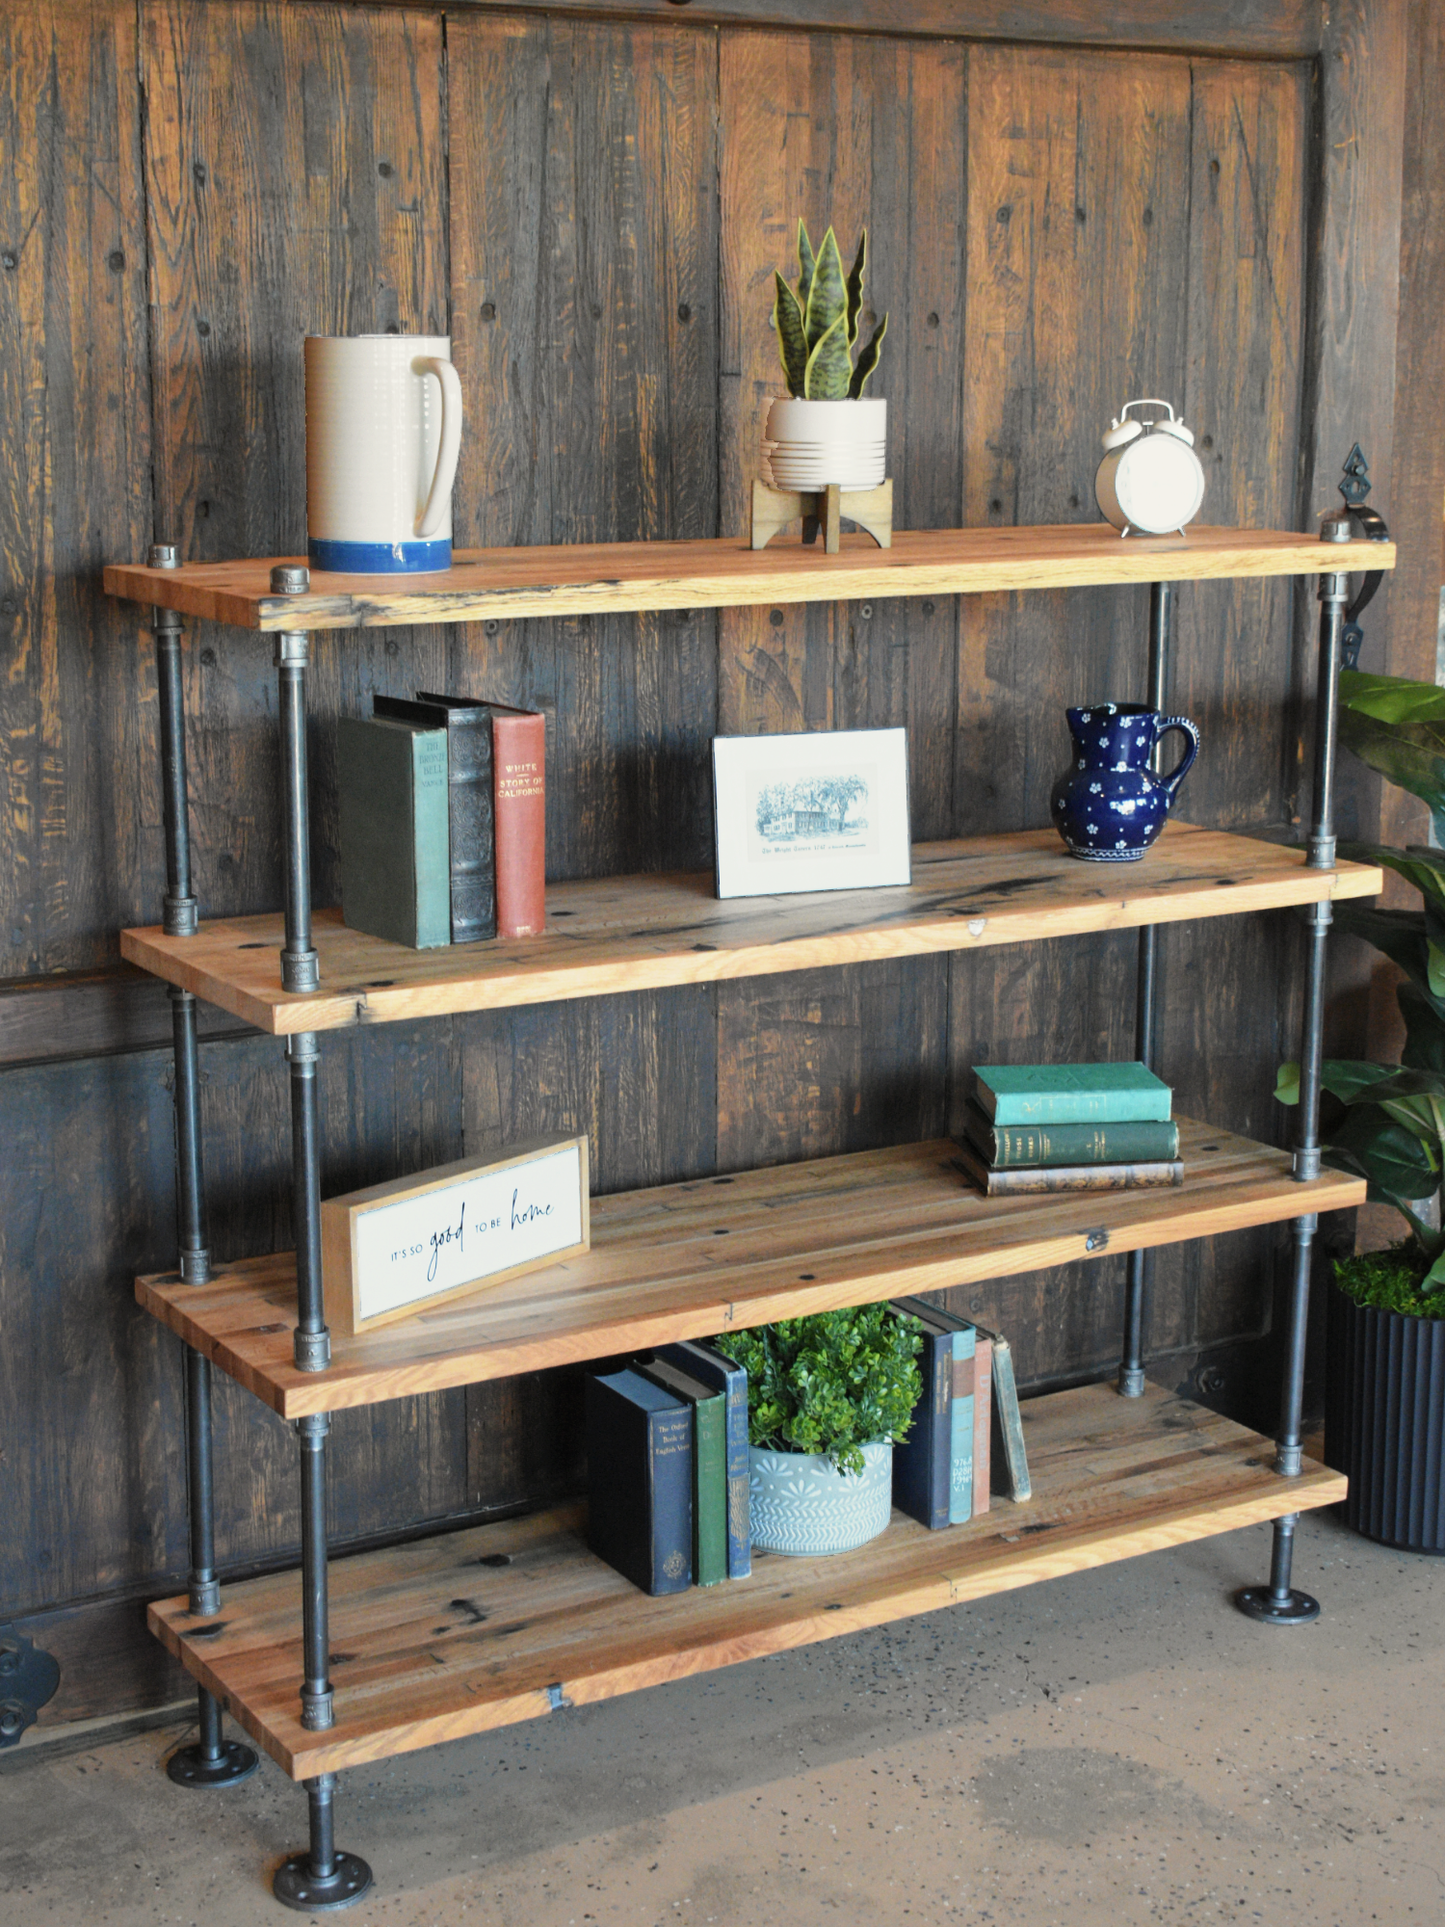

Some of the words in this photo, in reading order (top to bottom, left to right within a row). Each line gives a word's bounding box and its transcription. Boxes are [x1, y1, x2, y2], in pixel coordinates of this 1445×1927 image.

[426, 742, 439, 751] THE
[423, 765, 443, 775] BELL
[505, 763, 537, 773] WHITE
[500, 778, 530, 788] STORY
[533, 776, 543, 785] OF
[498, 787, 545, 798] CALIFORNIA
[391, 1249, 407, 1262] IT'S
[410, 1243, 423, 1256] SO
[427, 1201, 465, 1282] good
[475, 1222, 487, 1233] TO
[490, 1217, 501, 1229] BE
[511, 1188, 554, 1230] home
[663, 1435, 678, 1444] Book
[679, 1433, 685, 1441] of
[655, 1446, 676, 1455] English
